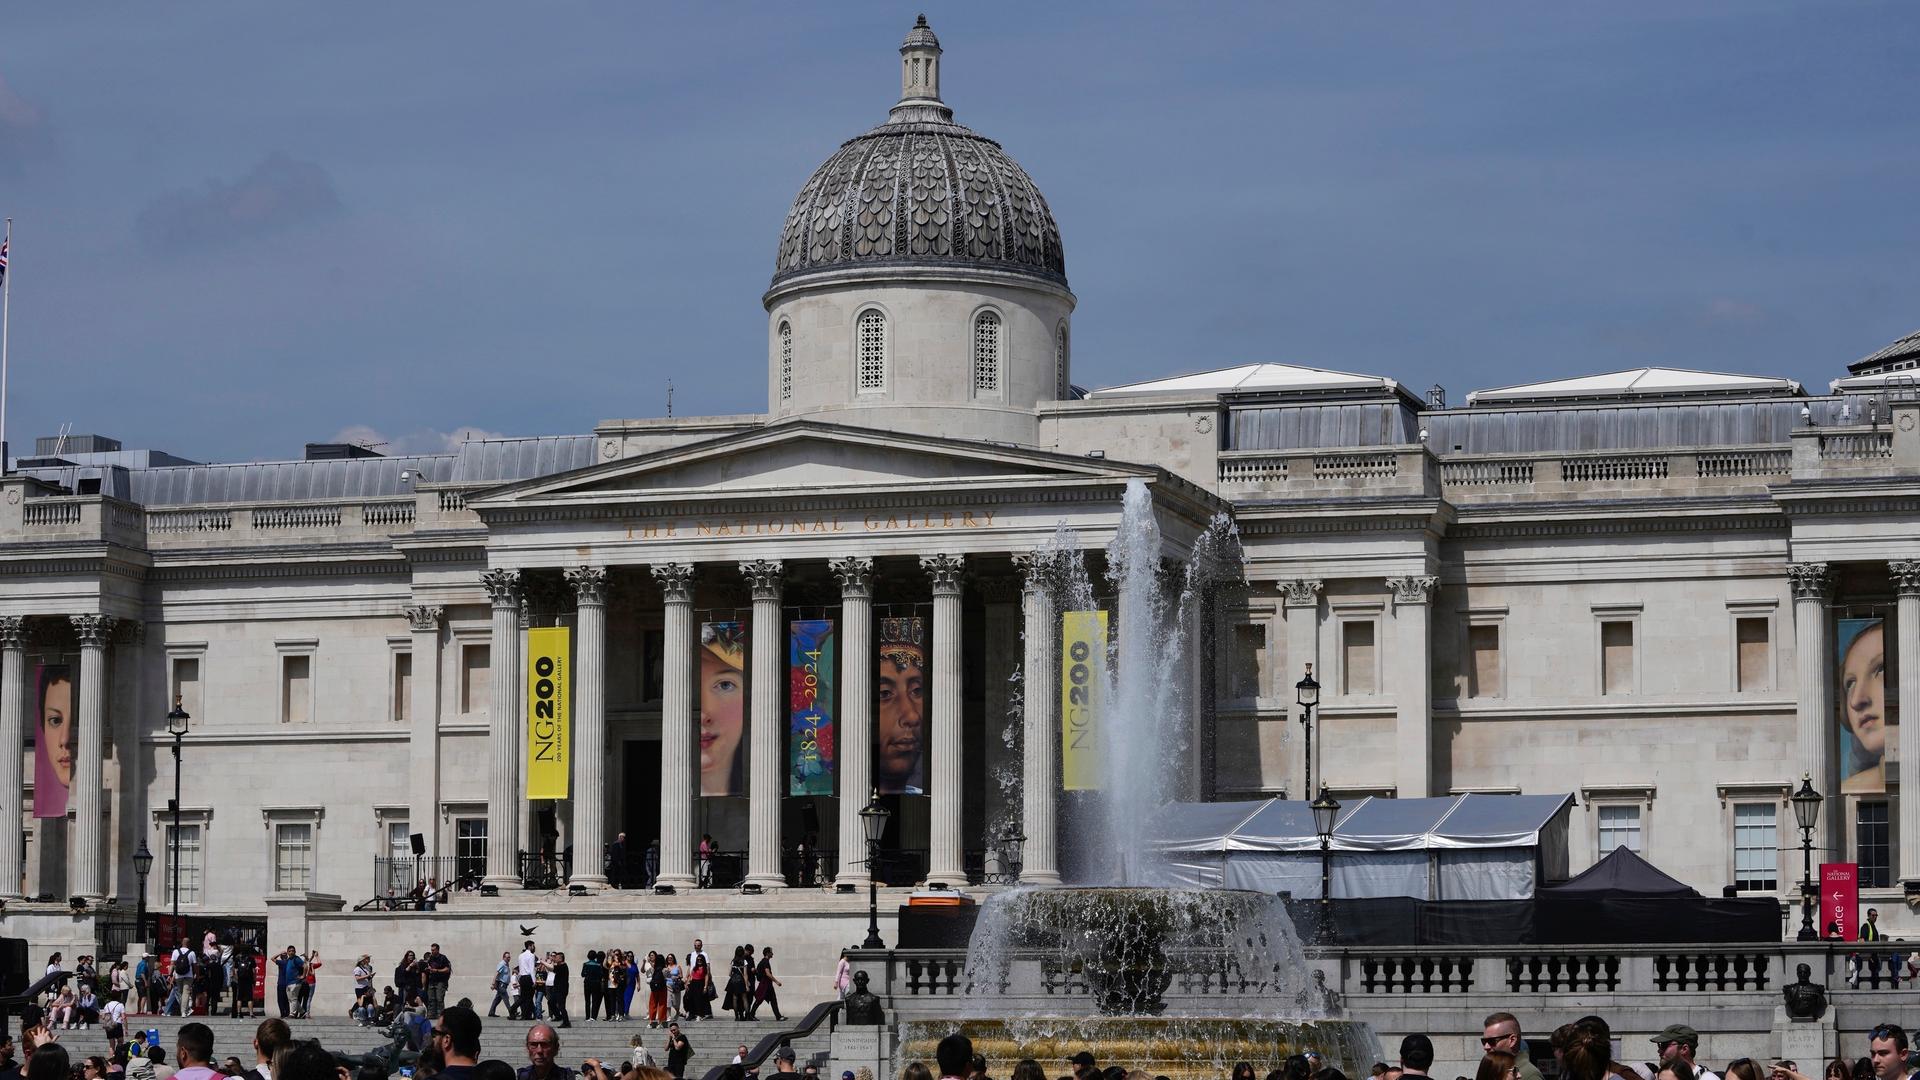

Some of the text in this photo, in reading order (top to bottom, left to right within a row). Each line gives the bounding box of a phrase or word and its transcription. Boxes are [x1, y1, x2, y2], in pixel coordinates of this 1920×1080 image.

[624, 510, 997, 538] THE NATIONAL GALLERY
[535, 656, 555, 762] NG200
[1069, 640, 1090, 750] NG200
[1835, 905, 1844, 937] ance
